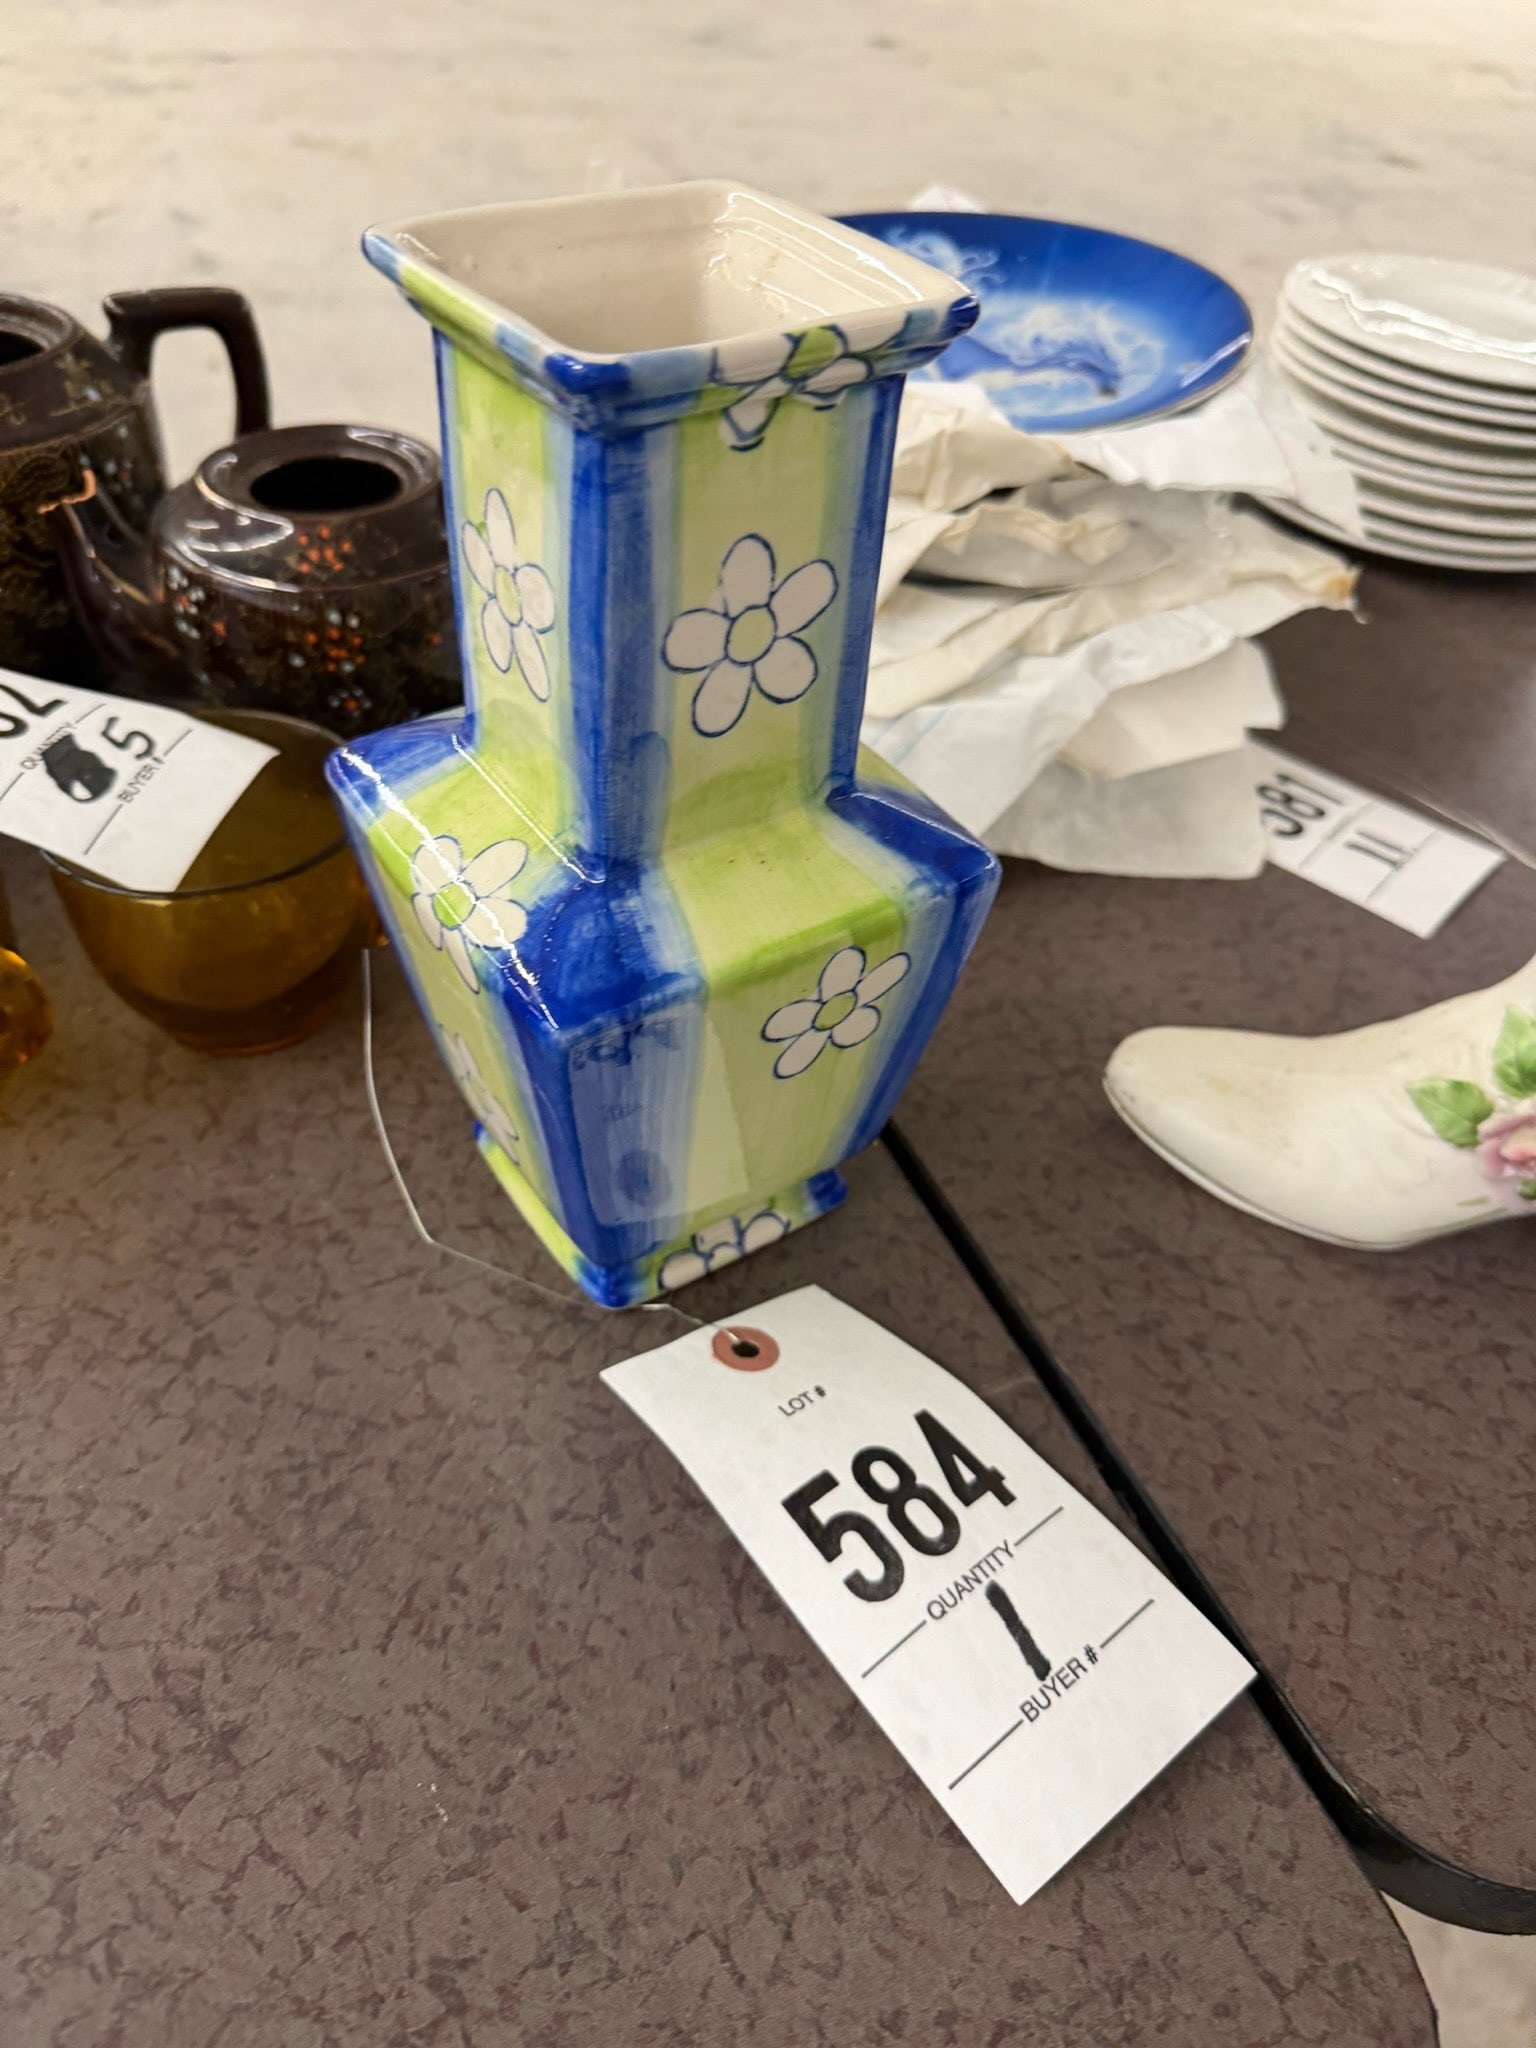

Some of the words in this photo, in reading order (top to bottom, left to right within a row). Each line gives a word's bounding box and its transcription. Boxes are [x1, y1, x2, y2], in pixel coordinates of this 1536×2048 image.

[101, 716, 156, 759] 5
[778, 1391, 814, 1417] LOT
[814, 1385, 827, 1398] #
[781, 1409, 1017, 1602] 584
[926, 1540, 1015, 1622] QUANTITY
[985, 1580, 1051, 1681] 1
[1018, 1658, 1088, 1723] BUYER
[1084, 1644, 1099, 1666] #
